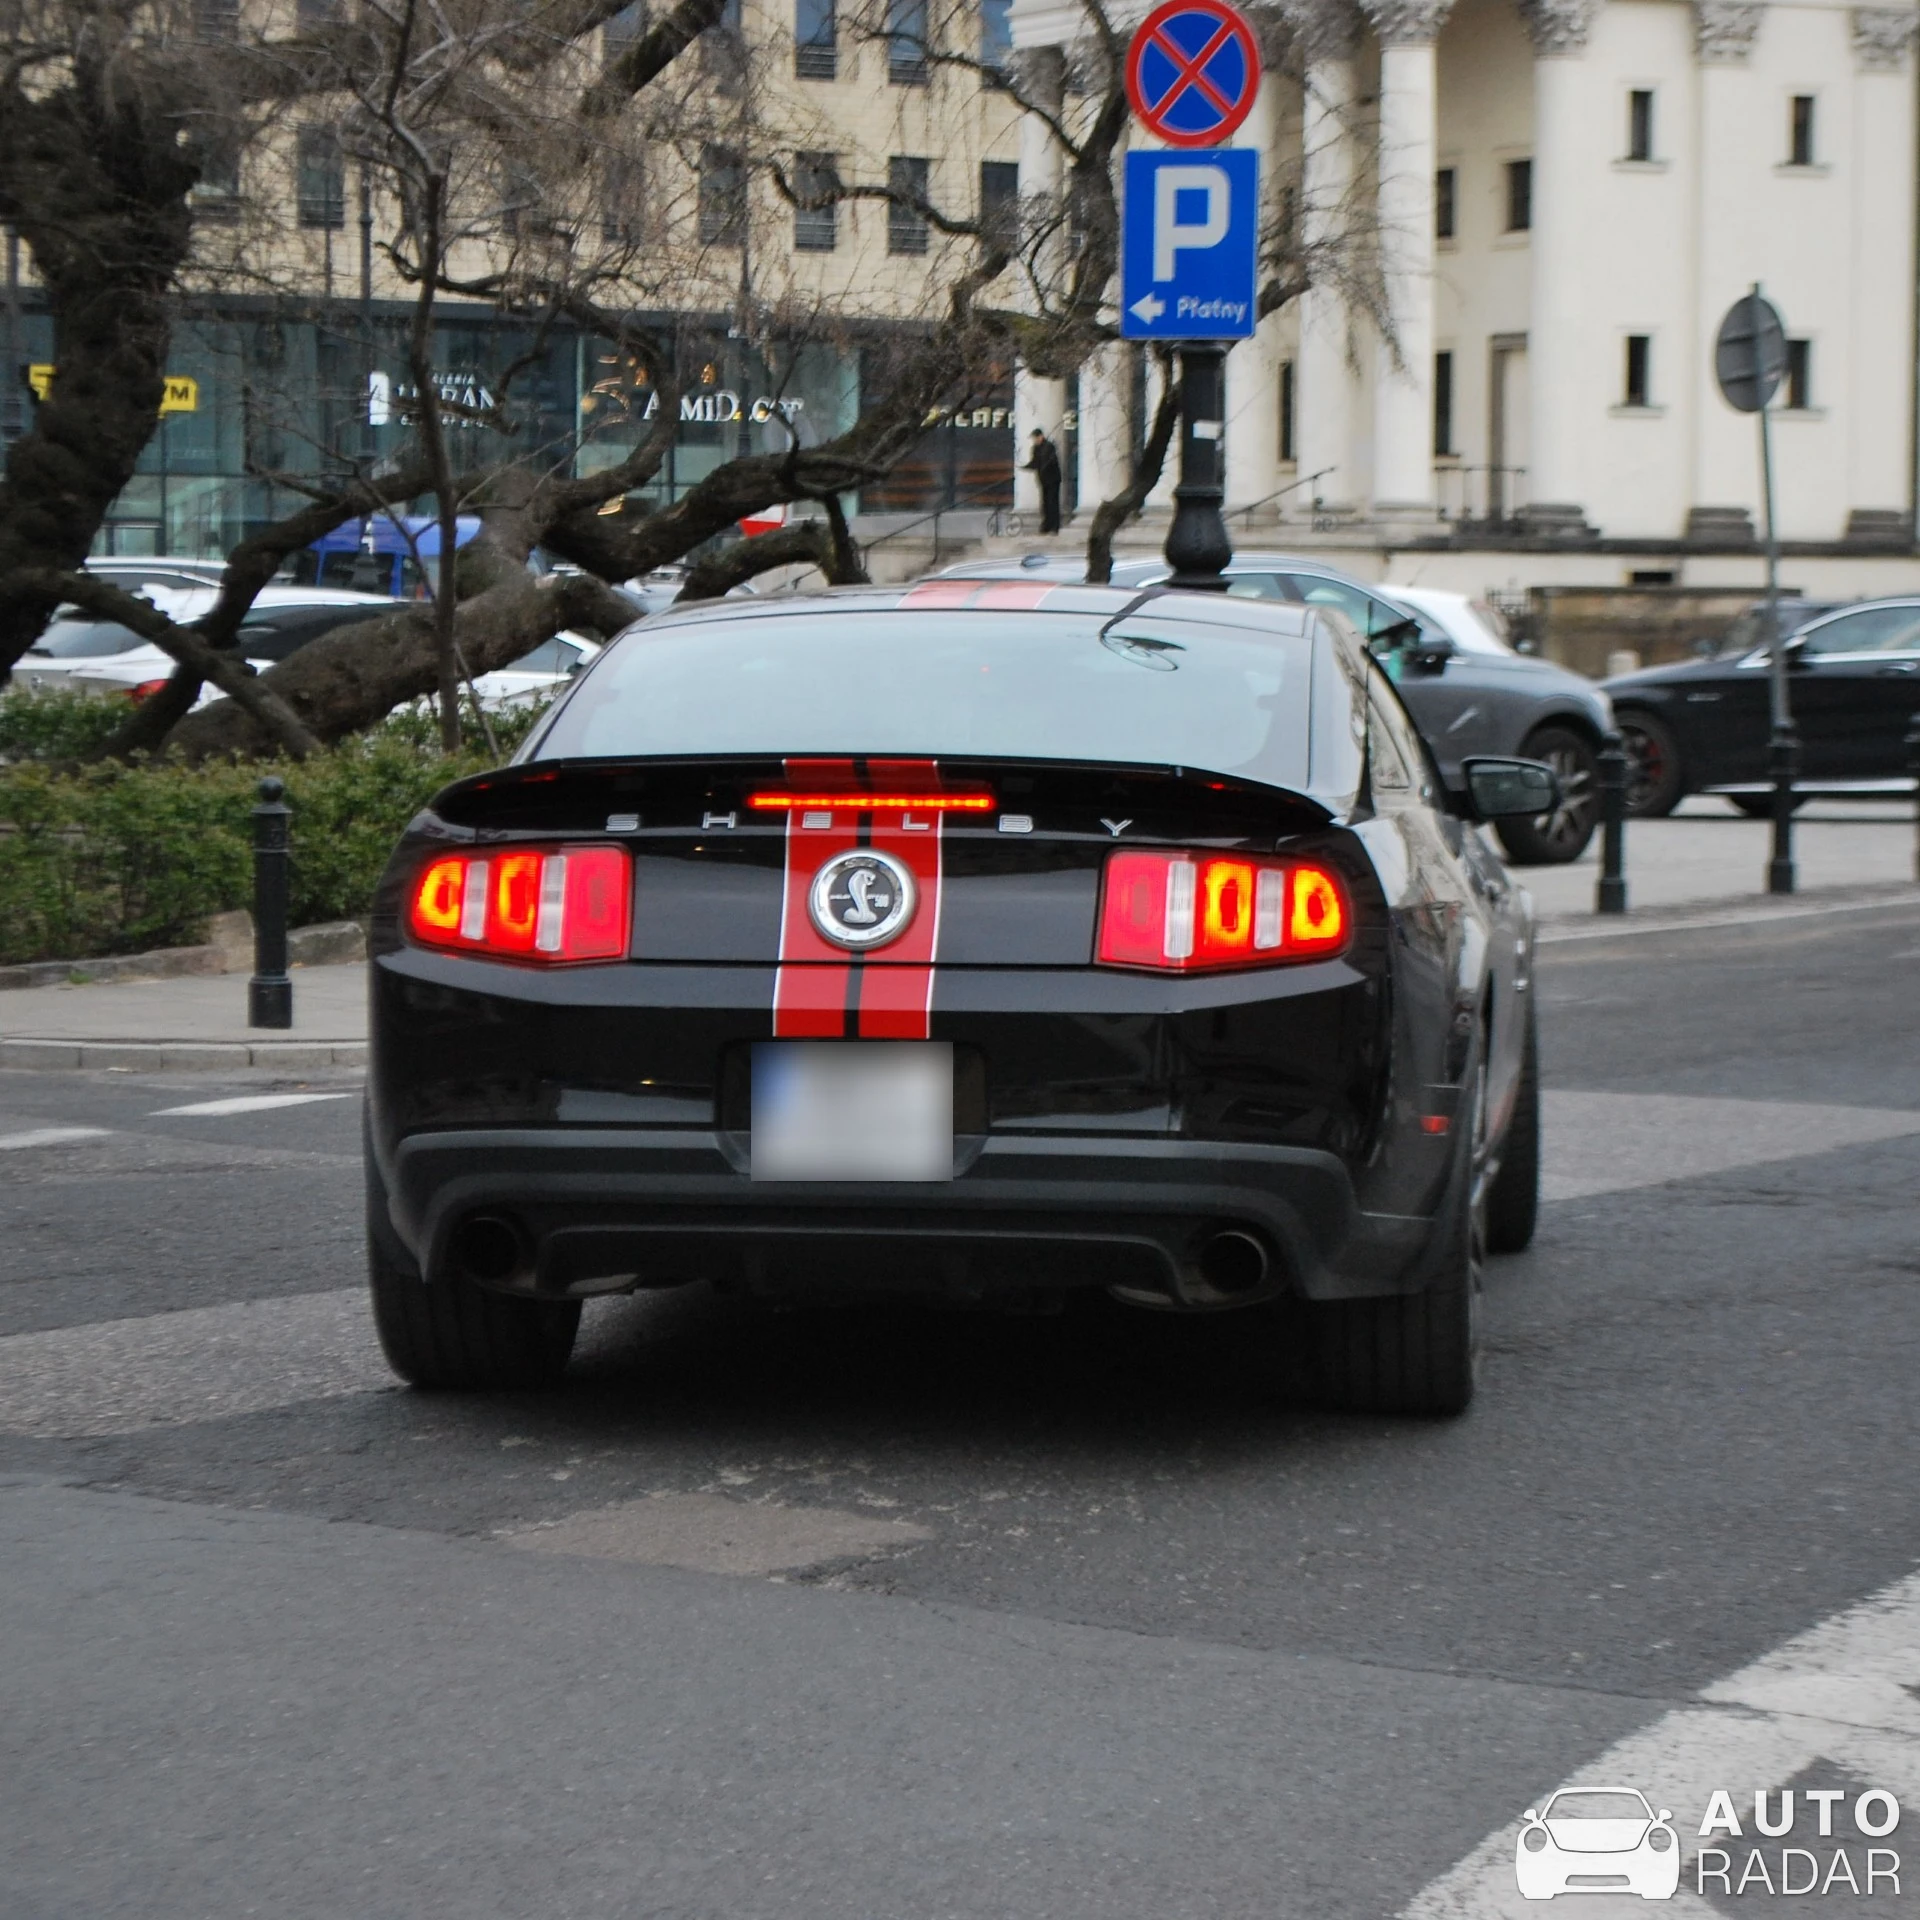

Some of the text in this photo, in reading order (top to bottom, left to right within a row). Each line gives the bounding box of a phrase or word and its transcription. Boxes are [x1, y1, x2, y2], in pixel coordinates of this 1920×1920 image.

[1153, 165, 1231, 282] P
[1176, 296, 1248, 324] Płatny
[605, 810, 1133, 838] SHELBY
